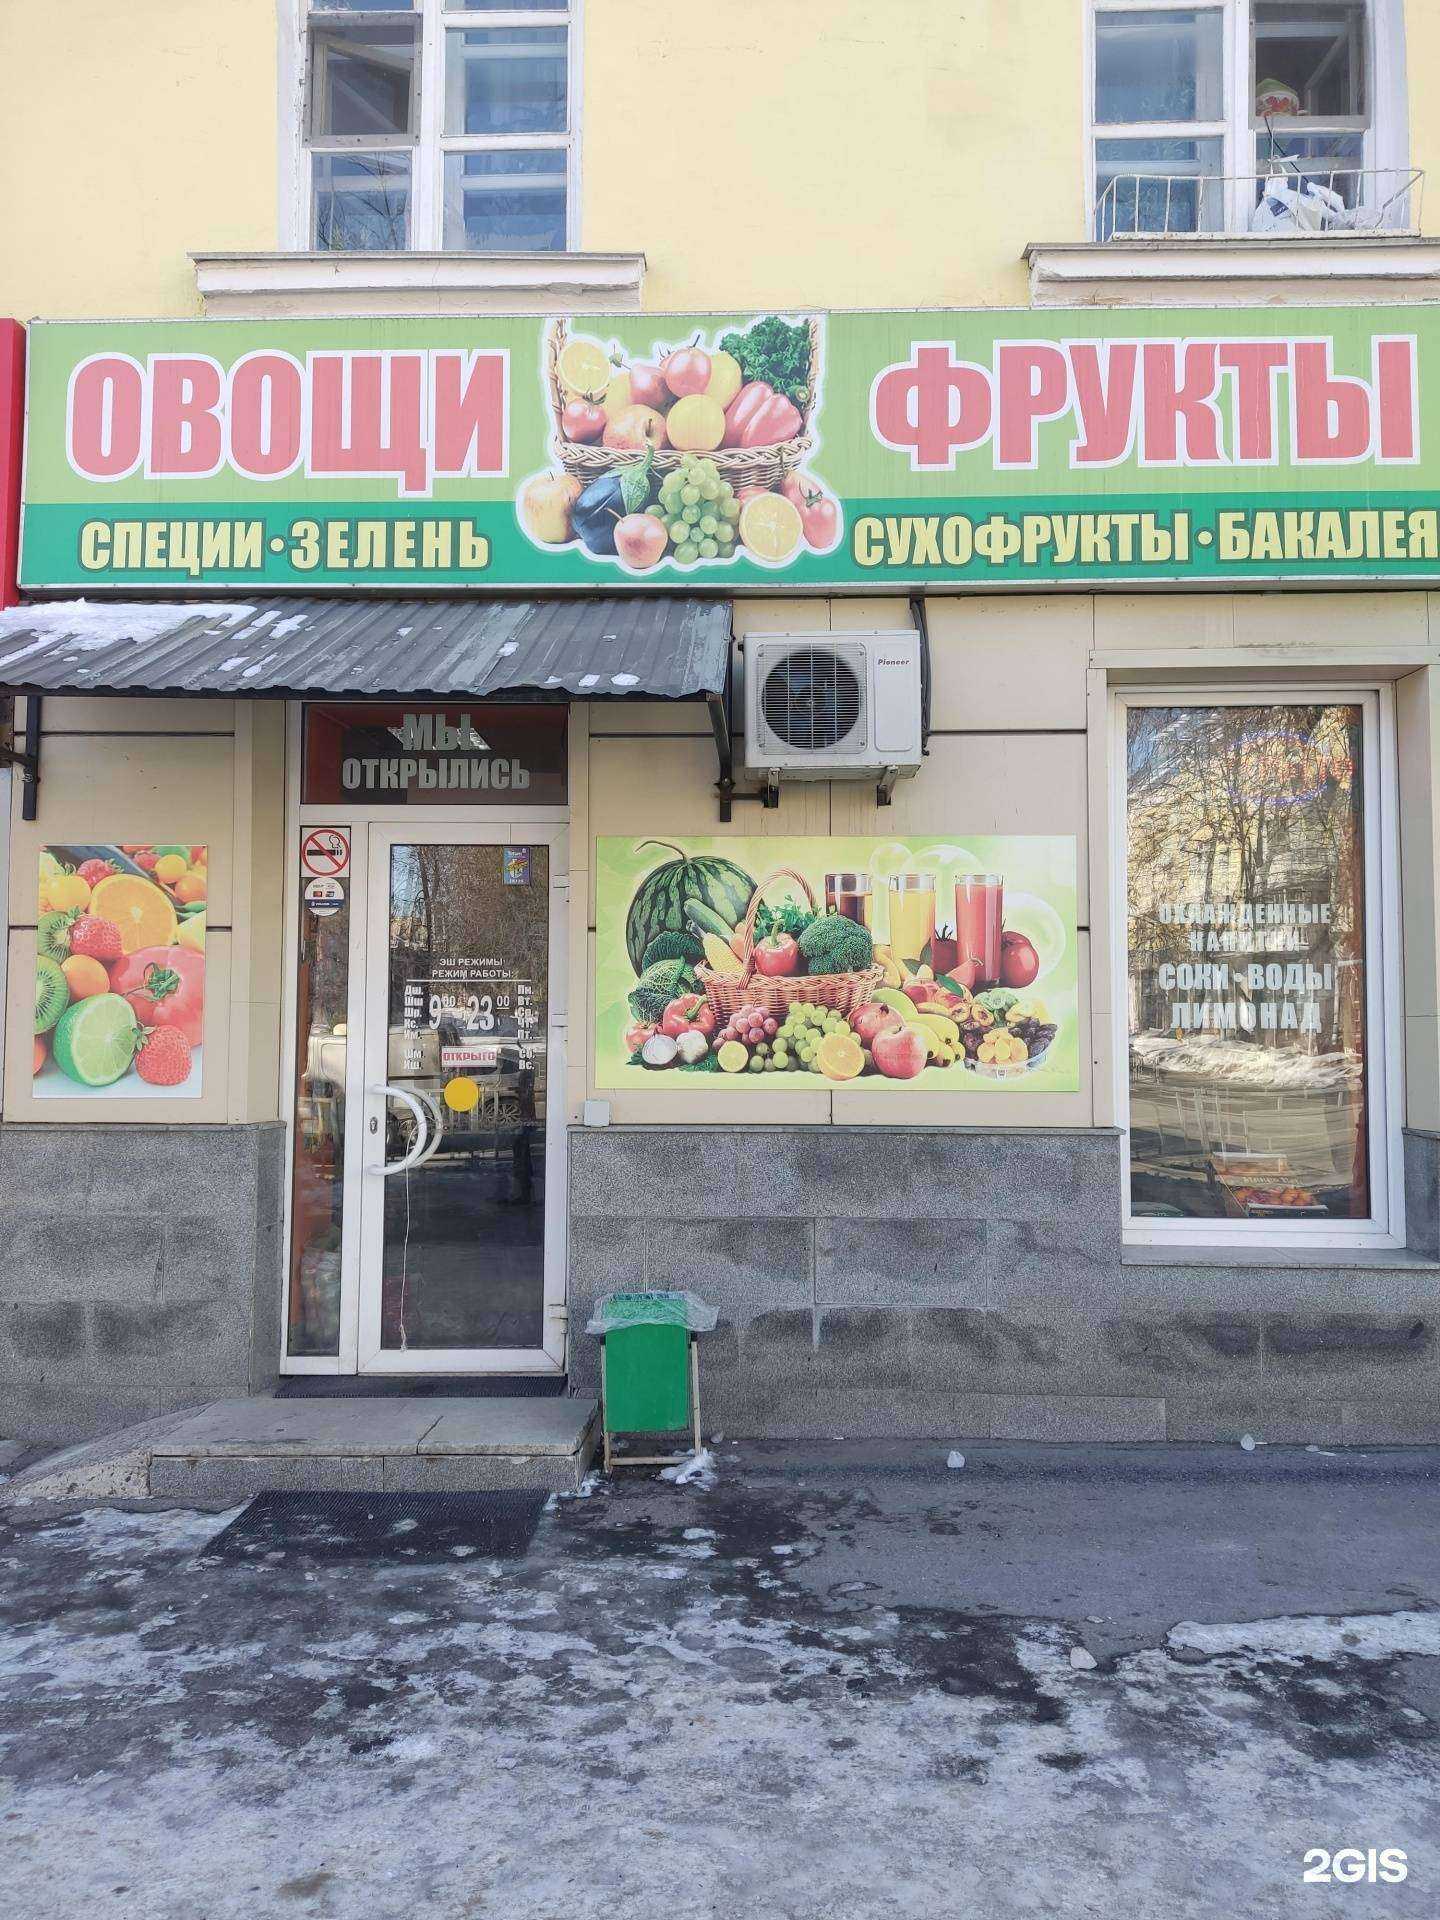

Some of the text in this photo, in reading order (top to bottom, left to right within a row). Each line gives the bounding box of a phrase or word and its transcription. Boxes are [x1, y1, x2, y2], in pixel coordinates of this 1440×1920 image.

[872, 338, 1417, 468] ФРУКТЫ
[69, 351, 507, 495] ОВОЩИ
[81, 519, 490, 576] СПЕЦИИ ЗЕЛЕНЬ
[853, 509, 1439, 566] СУХОФРУКТЫ БАКАЛЕЯ
[877, 658, 911, 666] Pioneer
[402, 713, 473, 751] МЫ
[342, 757, 530, 790] ОТКРЫЛИСЬ
[432, 969, 468, 978] РЕЖИМ
[439, 958, 456, 966] ЭШ
[1158, 963, 1333, 994] СОКИ ВОДЫ
[1170, 1002, 1323, 1033] ЛИМОНАД
[443, 1052, 496, 1061] ОТКРЫТО
